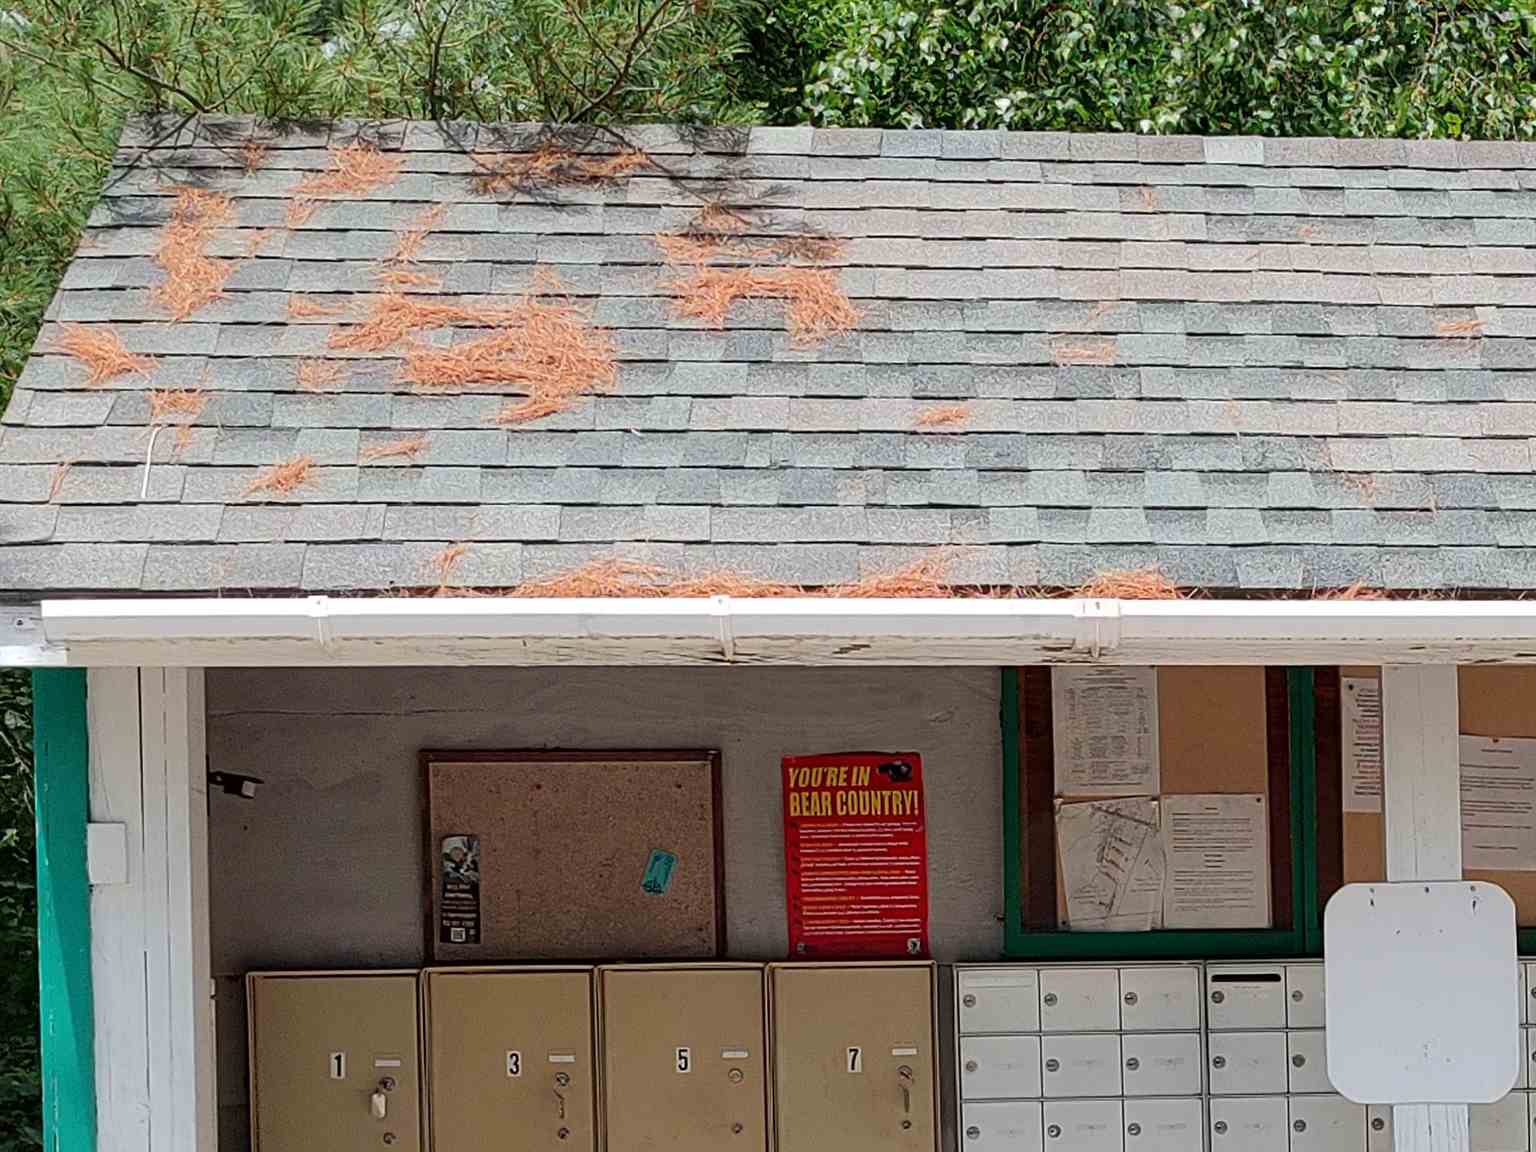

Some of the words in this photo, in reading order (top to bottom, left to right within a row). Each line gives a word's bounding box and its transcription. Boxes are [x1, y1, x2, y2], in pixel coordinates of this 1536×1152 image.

[788, 766, 849, 788] YOU'RE
[851, 766, 871, 787] IN
[789, 790, 833, 817] BEAR
[836, 790, 919, 816] COUNTRY!
[333, 1053, 343, 1078] 1
[509, 1052, 520, 1075] 3
[677, 1048, 689, 1071] 5
[848, 1048, 859, 1071] 7
